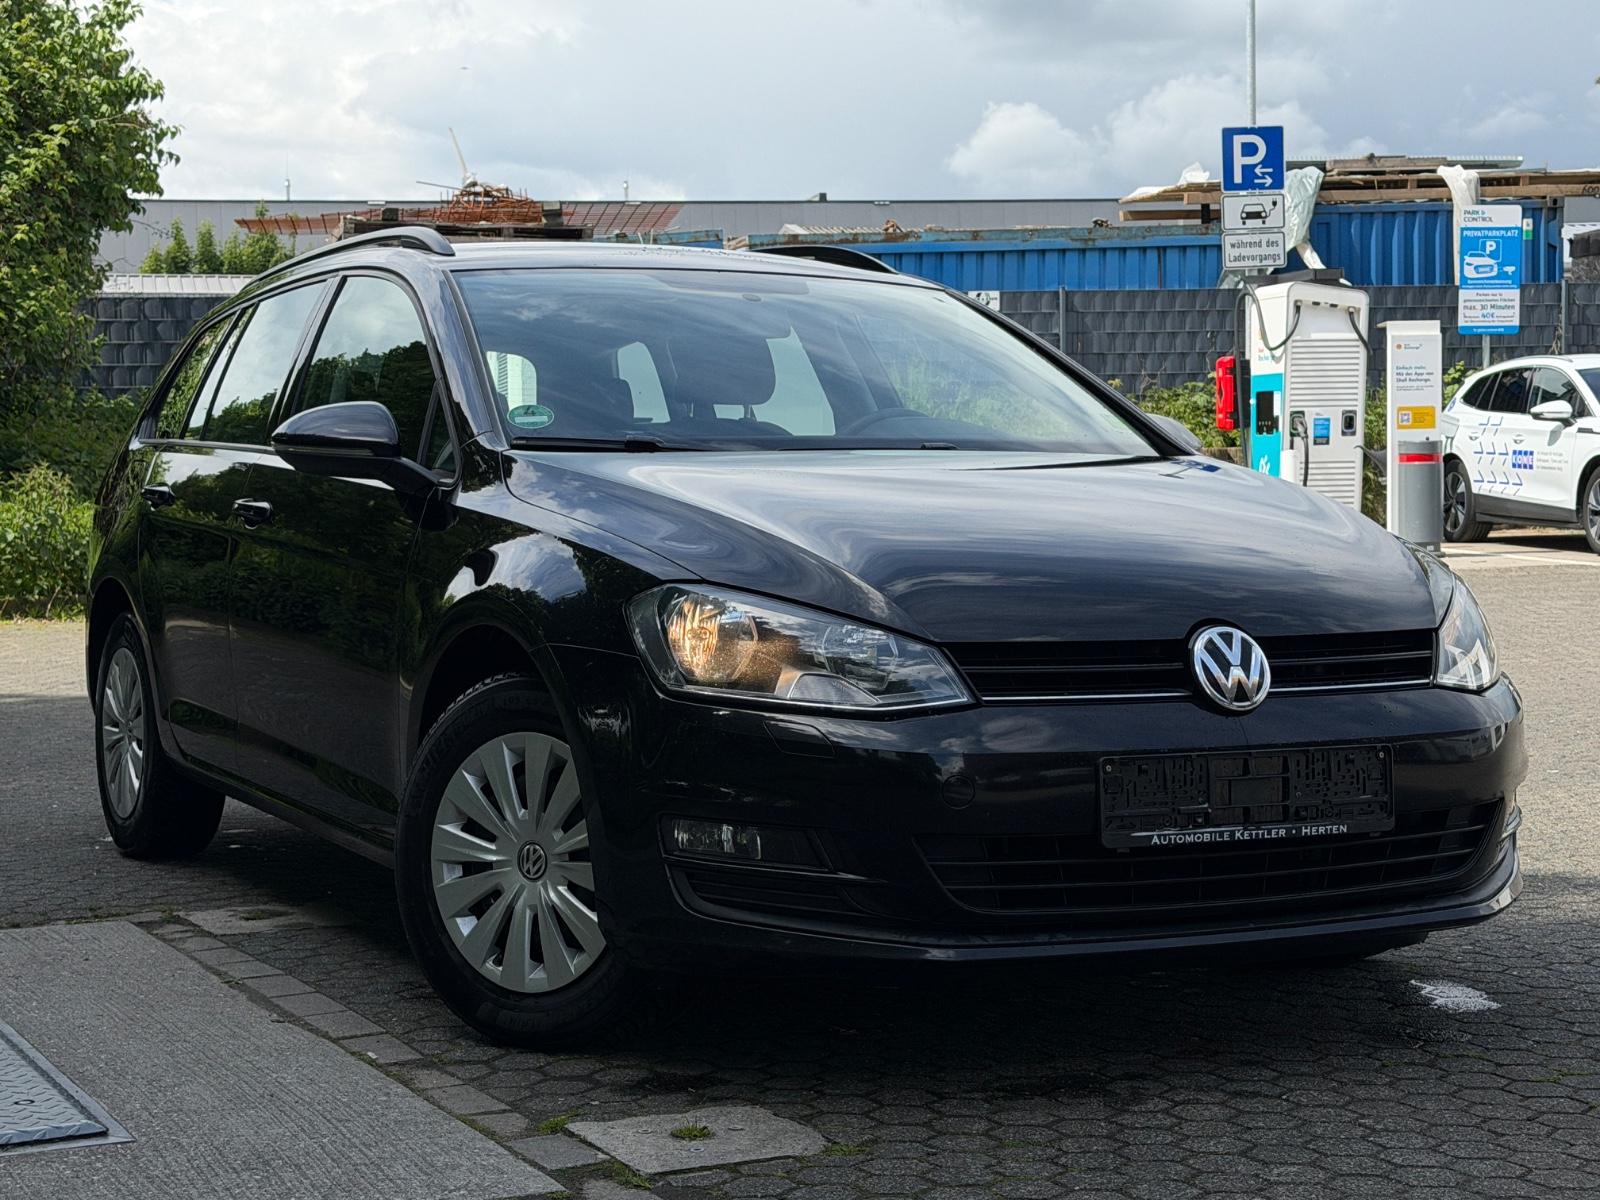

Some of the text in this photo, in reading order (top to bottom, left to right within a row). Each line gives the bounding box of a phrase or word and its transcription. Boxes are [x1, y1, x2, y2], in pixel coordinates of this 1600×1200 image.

[1233, 135, 1267, 184] P
[1463, 229, 1519, 237] PRIVATPARKPLATZ
[1230, 238, 1279, 249] während des
[1485, 240, 1497, 255] P
[1228, 252, 1281, 263] Ladevorgangs
[1480, 303, 1489, 311] 30
[1490, 303, 1516, 311] Minuten
[1151, 824, 1348, 845] AUTOMOBILE KETTLER HERTEN
